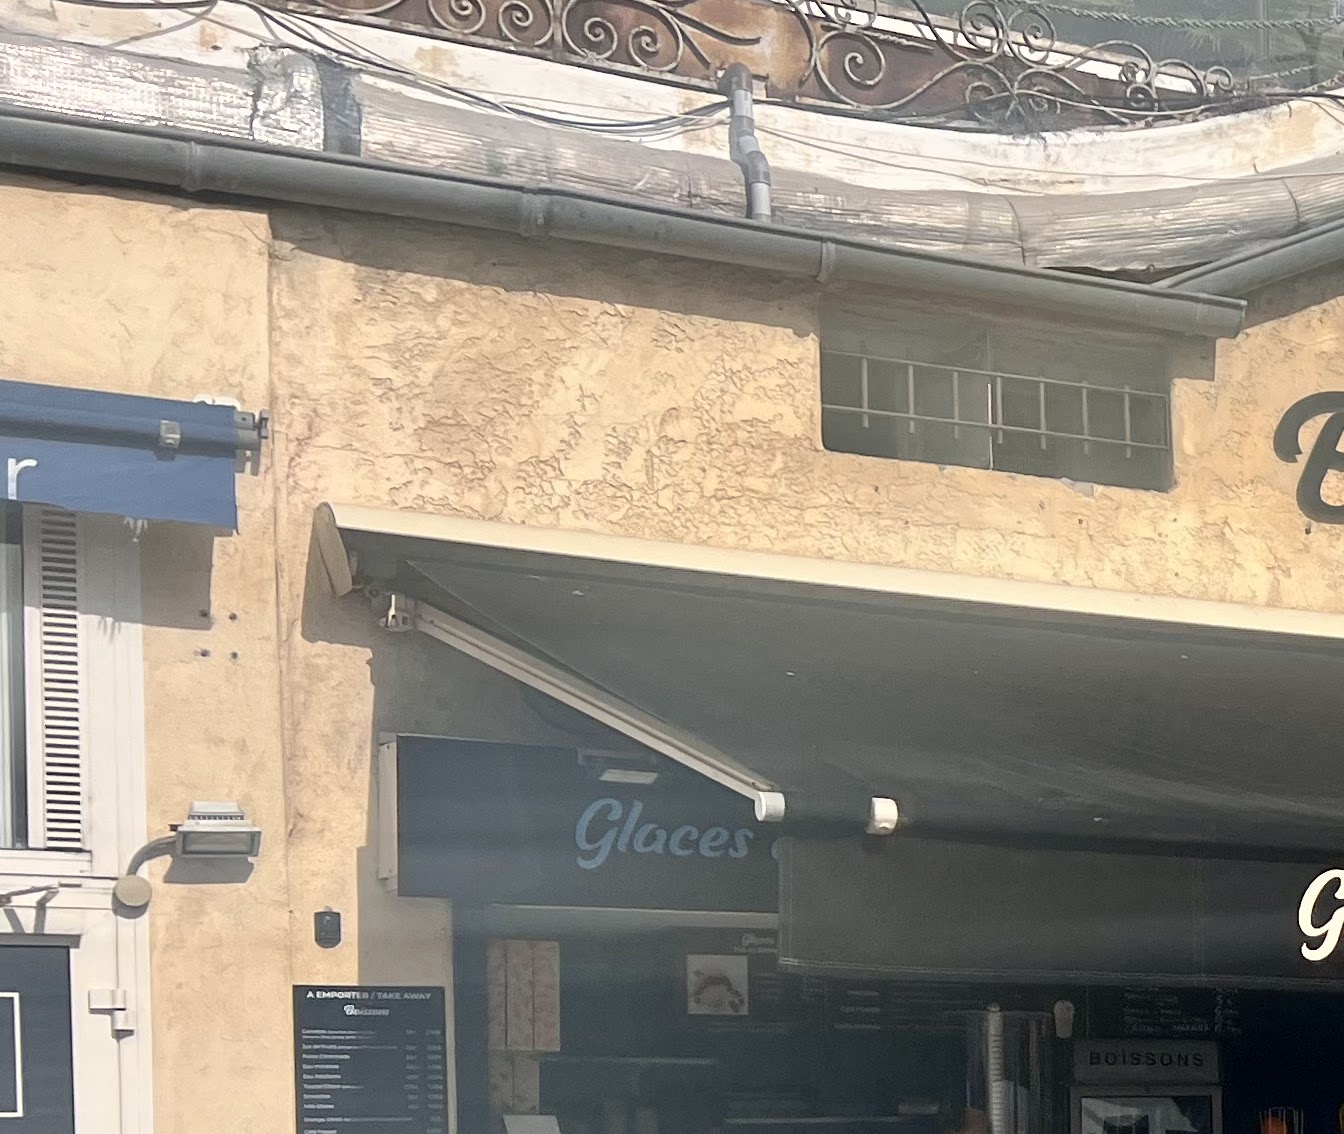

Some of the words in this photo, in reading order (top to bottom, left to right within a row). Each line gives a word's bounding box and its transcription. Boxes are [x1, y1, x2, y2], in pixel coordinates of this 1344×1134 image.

[575, 797, 755, 870] Glaces
[316, 990, 370, 1000] EMPORTER
[403, 991, 432, 1000] AWAY
[1089, 1048, 1204, 1067] BOISSONS
